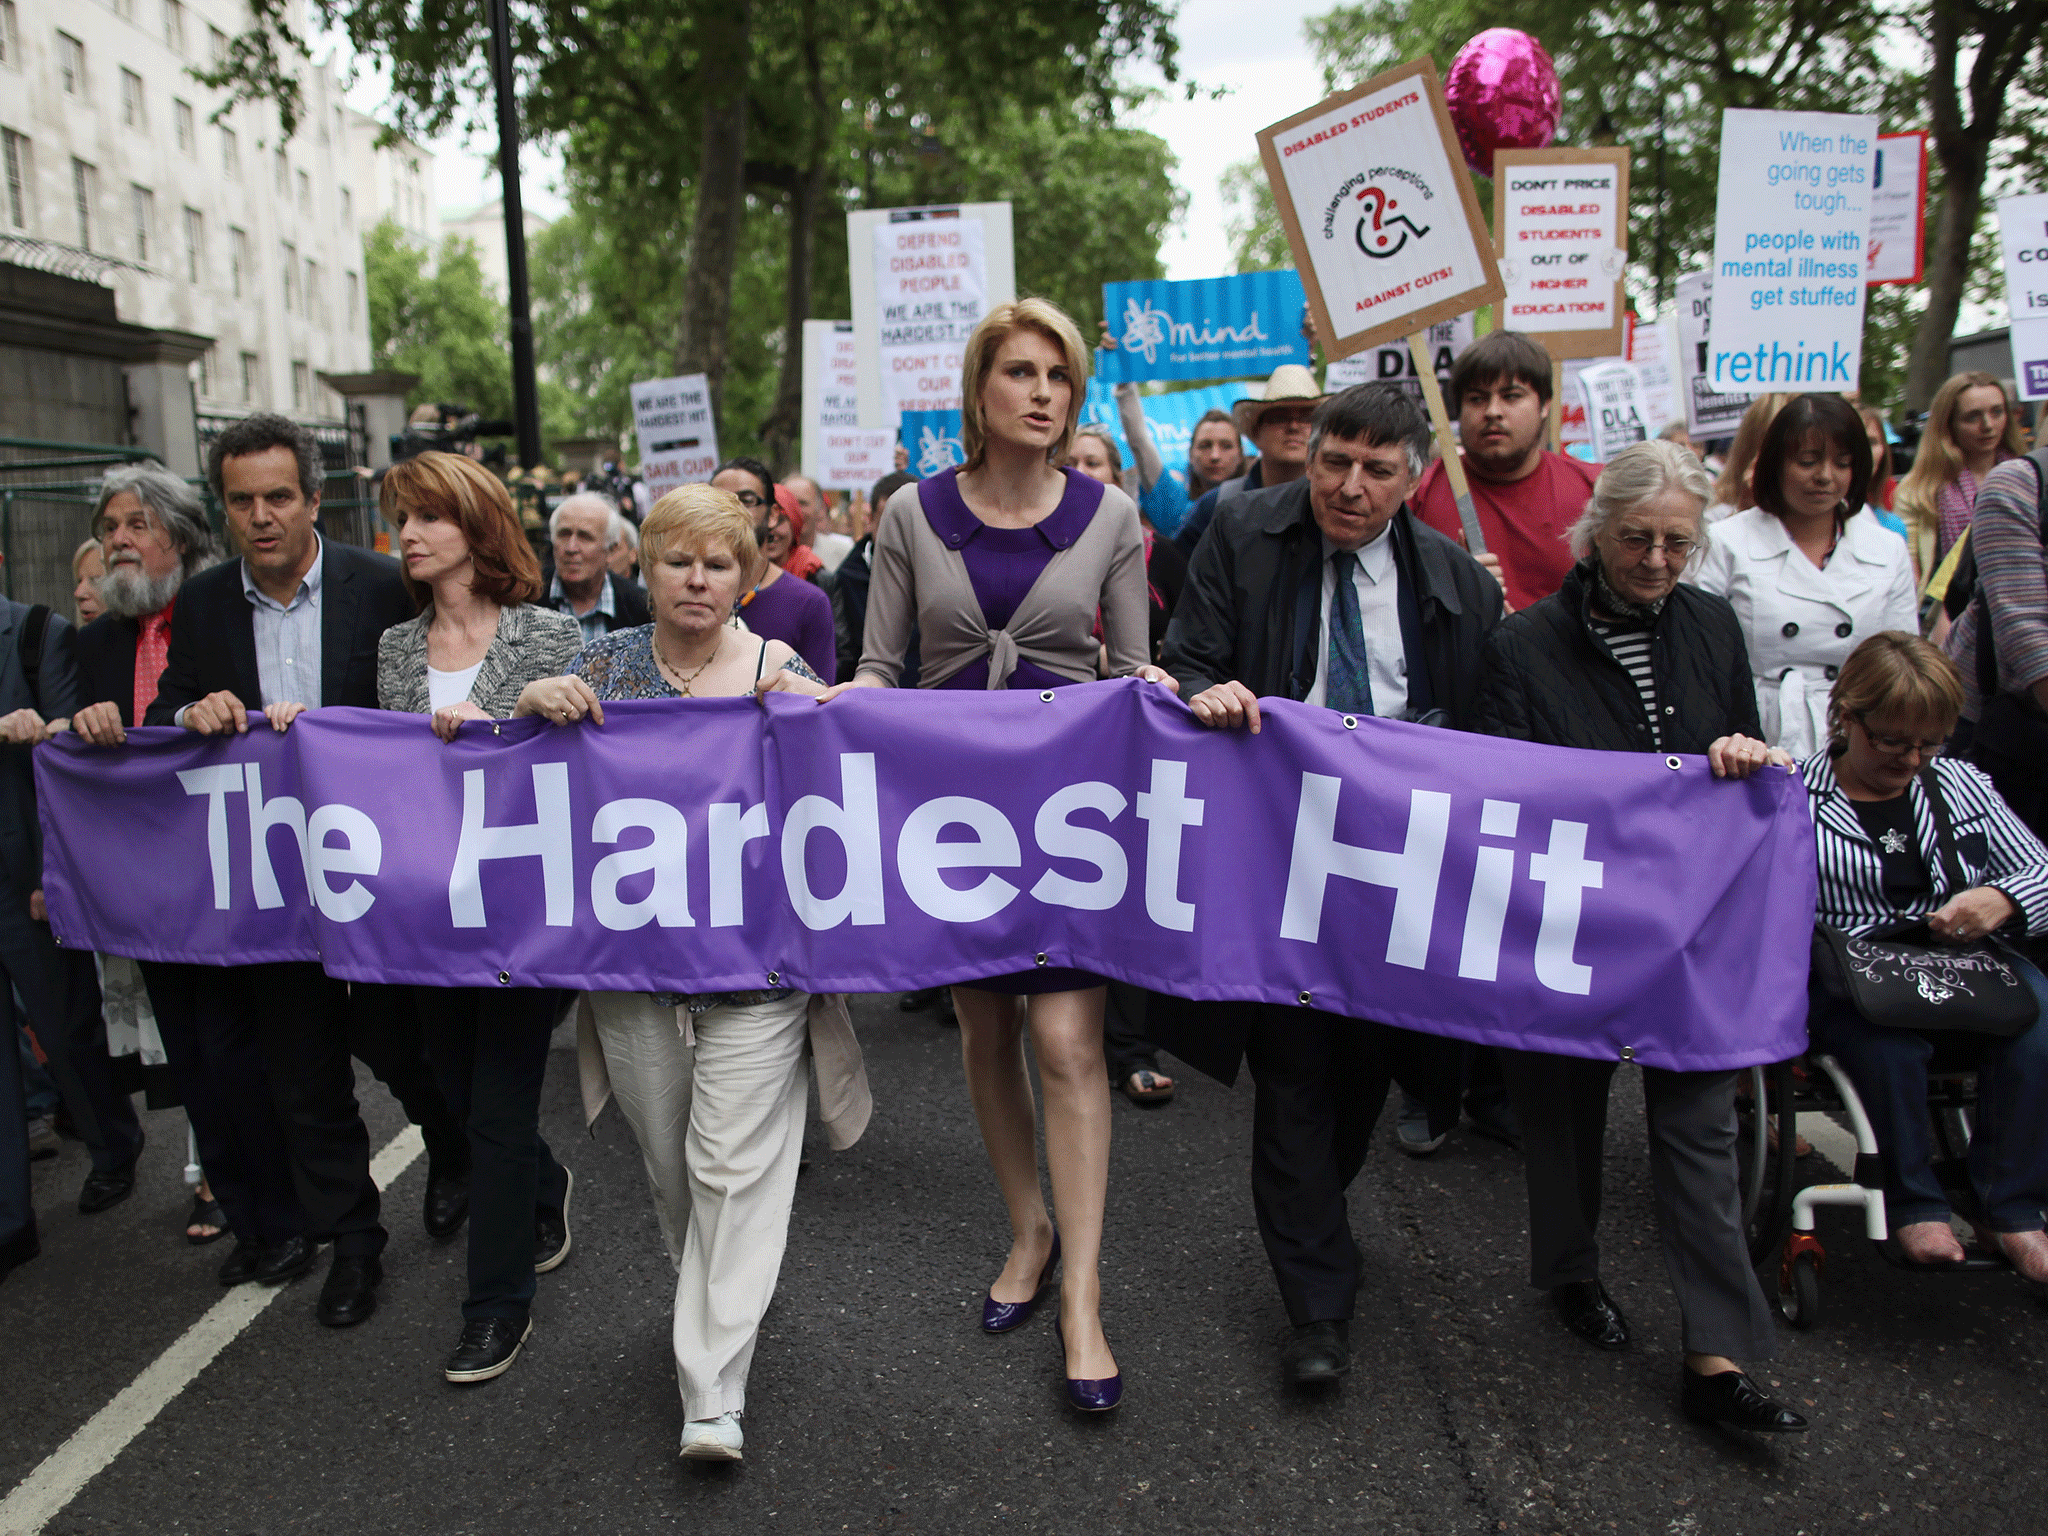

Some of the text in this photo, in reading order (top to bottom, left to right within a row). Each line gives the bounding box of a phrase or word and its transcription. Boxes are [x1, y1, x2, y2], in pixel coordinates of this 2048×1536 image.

[1283, 91, 1420, 157] DISABLED STUDENTS
[1780, 131, 1867, 155] When the
[1511, 178, 1611, 191] DON'T PRICE
[1768, 161, 1865, 187] going gets
[1323, 166, 1434, 240] challenging perceptions
[1521, 204, 1600, 216] DISABLED
[1795, 191, 1862, 216] tough...
[897, 232, 961, 250] DEFEND
[1519, 229, 1602, 241] STUDENTS
[1745, 229, 1860, 254] people with
[890, 252, 970, 273] DISABLED
[1531, 253, 1589, 265] OUT OF
[1721, 258, 1859, 278] mental illness
[900, 275, 961, 293] PEOPLE
[1355, 266, 1453, 312] AGAINST CUTS!
[1531, 279, 1588, 290] HIGHER
[1751, 286, 1857, 310] get stuffed
[884, 300, 979, 321] WE ARE THE
[881, 323, 954, 343] HARDEST
[1171, 310, 1269, 347] mind
[892, 355, 939, 372] DON'T
[1715, 341, 1851, 383] rethink
[918, 376, 952, 392] OUR
[638, 398, 653, 412] WE
[681, 391, 702, 405] THE
[645, 456, 714, 479] SAVE OUR
[175, 751, 1604, 996] The Hardest Hit
